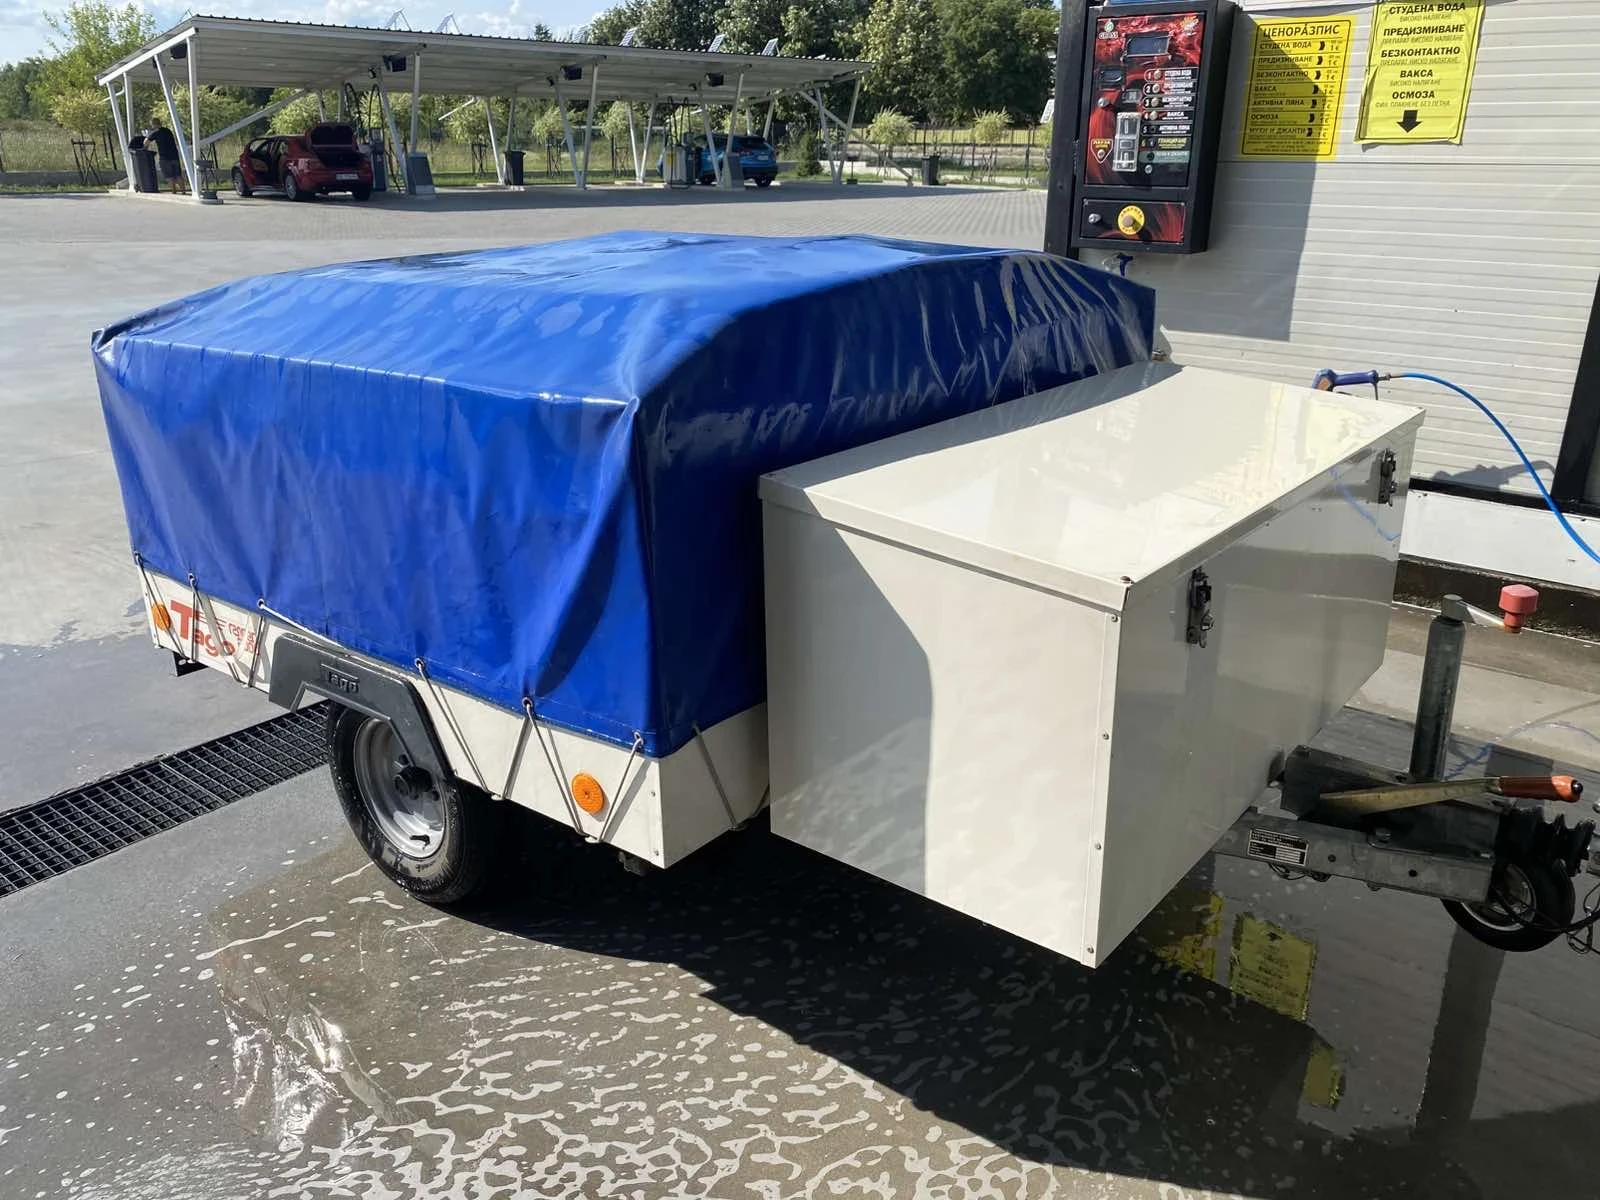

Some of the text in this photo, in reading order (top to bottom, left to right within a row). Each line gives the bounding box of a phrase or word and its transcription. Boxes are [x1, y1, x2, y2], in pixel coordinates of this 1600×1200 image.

[1389, 2, 1466, 15] СТУДЕНА ВОДА
[1263, 25, 1341, 38] ЦЕНОРАЗПИС
[1383, 24, 1466, 36] ПРЕДИЗМИВАНЕ
[1260, 41, 1312, 50] СТУДЕНА ВОДА
[1381, 47, 1461, 58] БЕЗКОНТАКТНО
[1258, 56, 1313, 64] ПРЕДИЗМИВАНЕ
[1400, 69, 1434, 78] ВАКСА
[1392, 90, 1436, 100] ОСМОЗА
[170, 599, 236, 657] Tago
